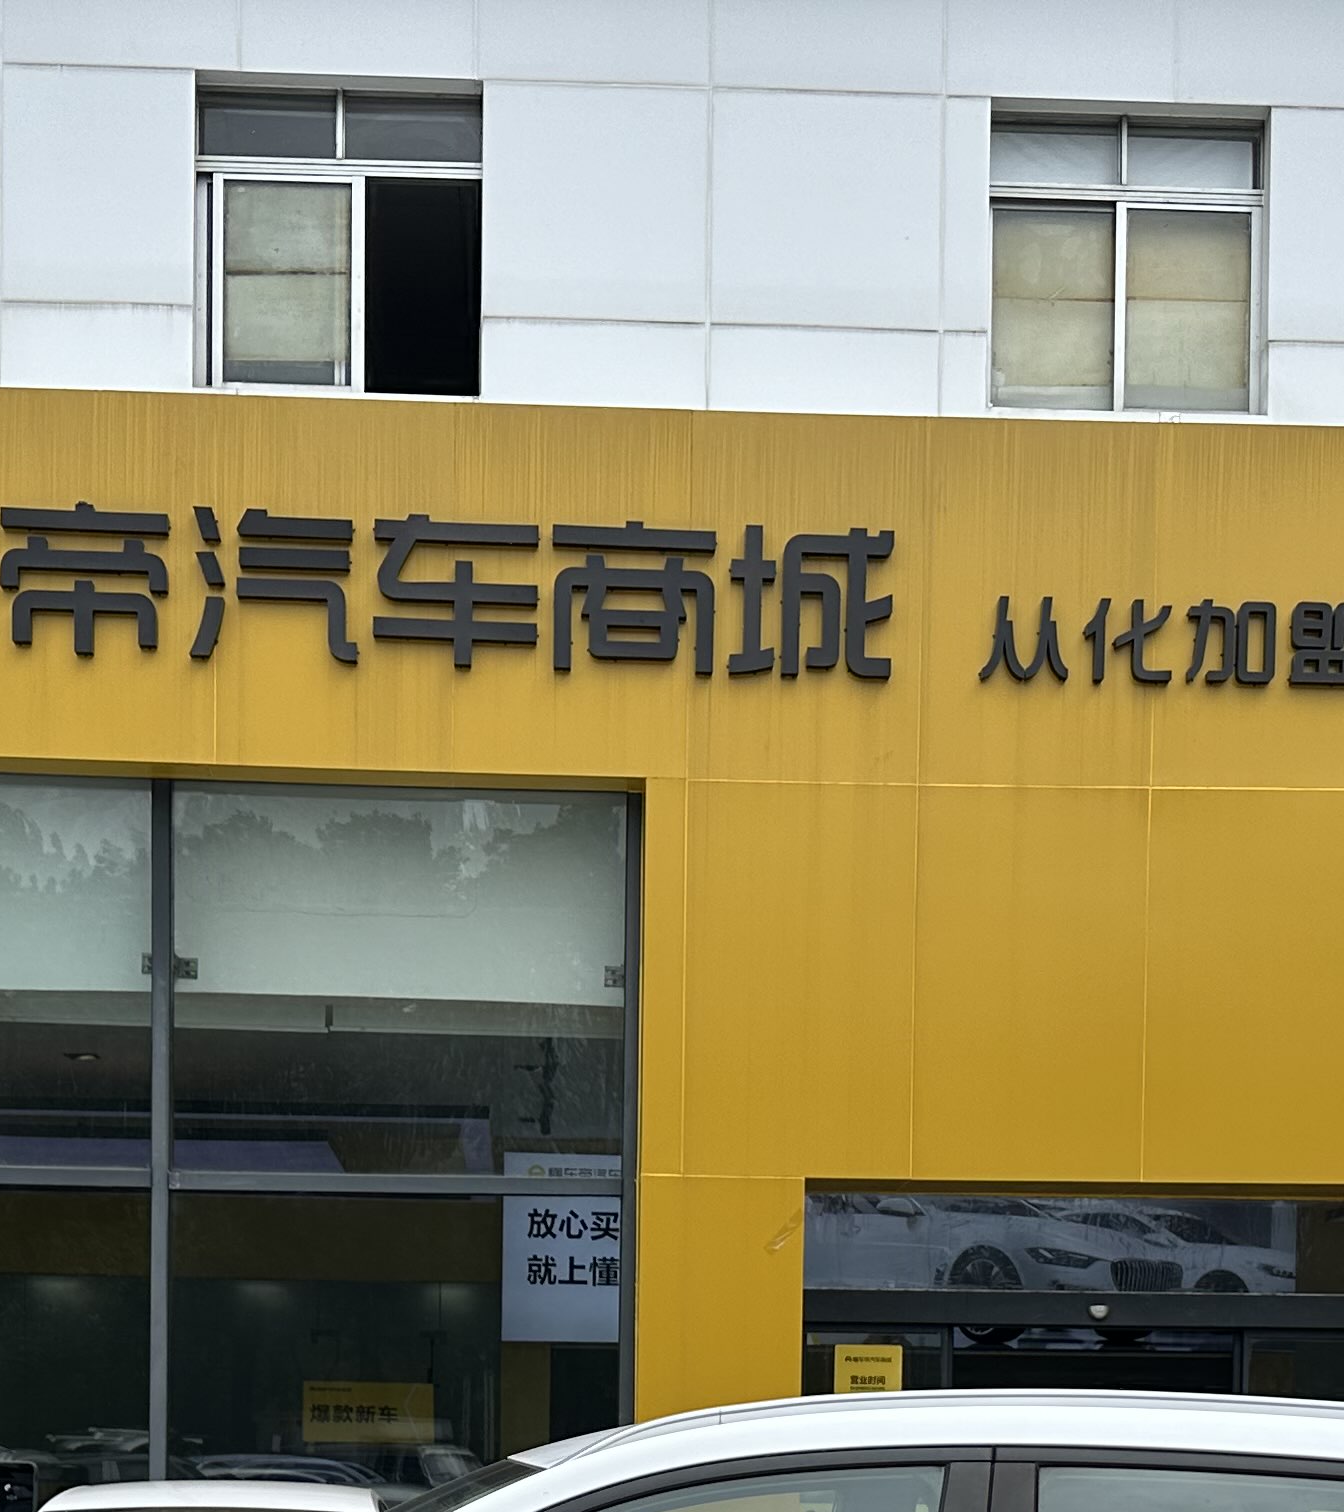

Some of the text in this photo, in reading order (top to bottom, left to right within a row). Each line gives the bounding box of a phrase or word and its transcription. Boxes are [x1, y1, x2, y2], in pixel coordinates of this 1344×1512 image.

[527, 1208, 620, 1241] 放心买
[527, 1254, 620, 1287] 就上懂
[309, 1403, 398, 1424] 爆款新车
